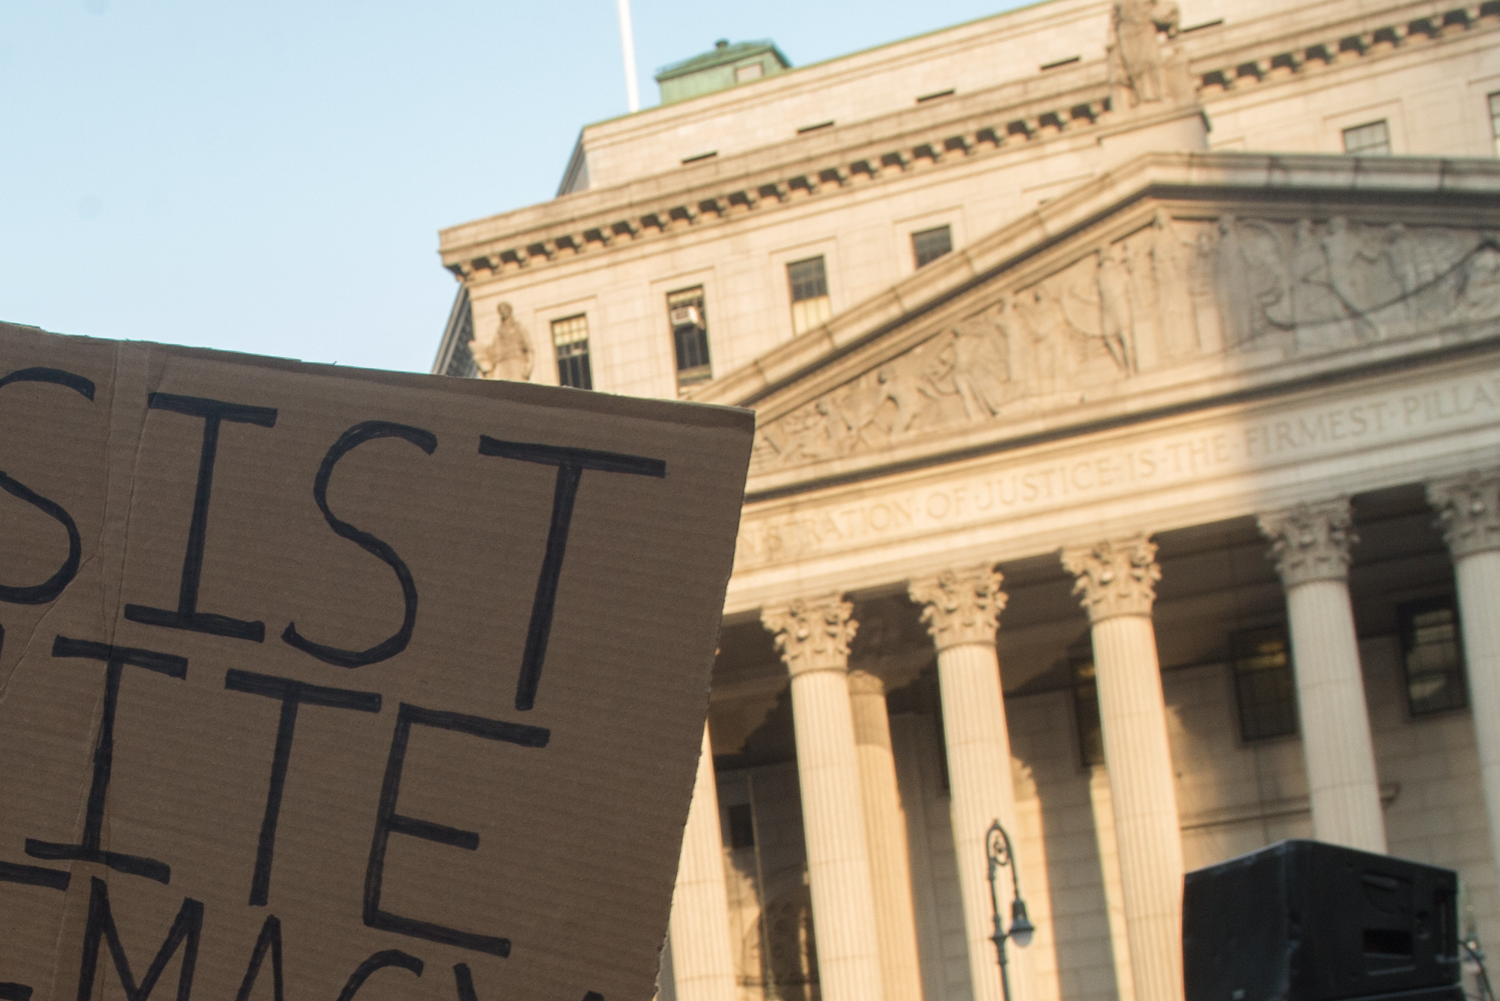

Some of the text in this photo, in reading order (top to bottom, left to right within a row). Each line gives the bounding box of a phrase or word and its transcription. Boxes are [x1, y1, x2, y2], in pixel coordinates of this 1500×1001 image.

[926, 486, 968, 519] OF
[978, 457, 1113, 511] JUSTICE
[1128, 449, 1156, 482] IS
[1166, 433, 1231, 476] THE
[1244, 401, 1388, 459] FIRMEST
